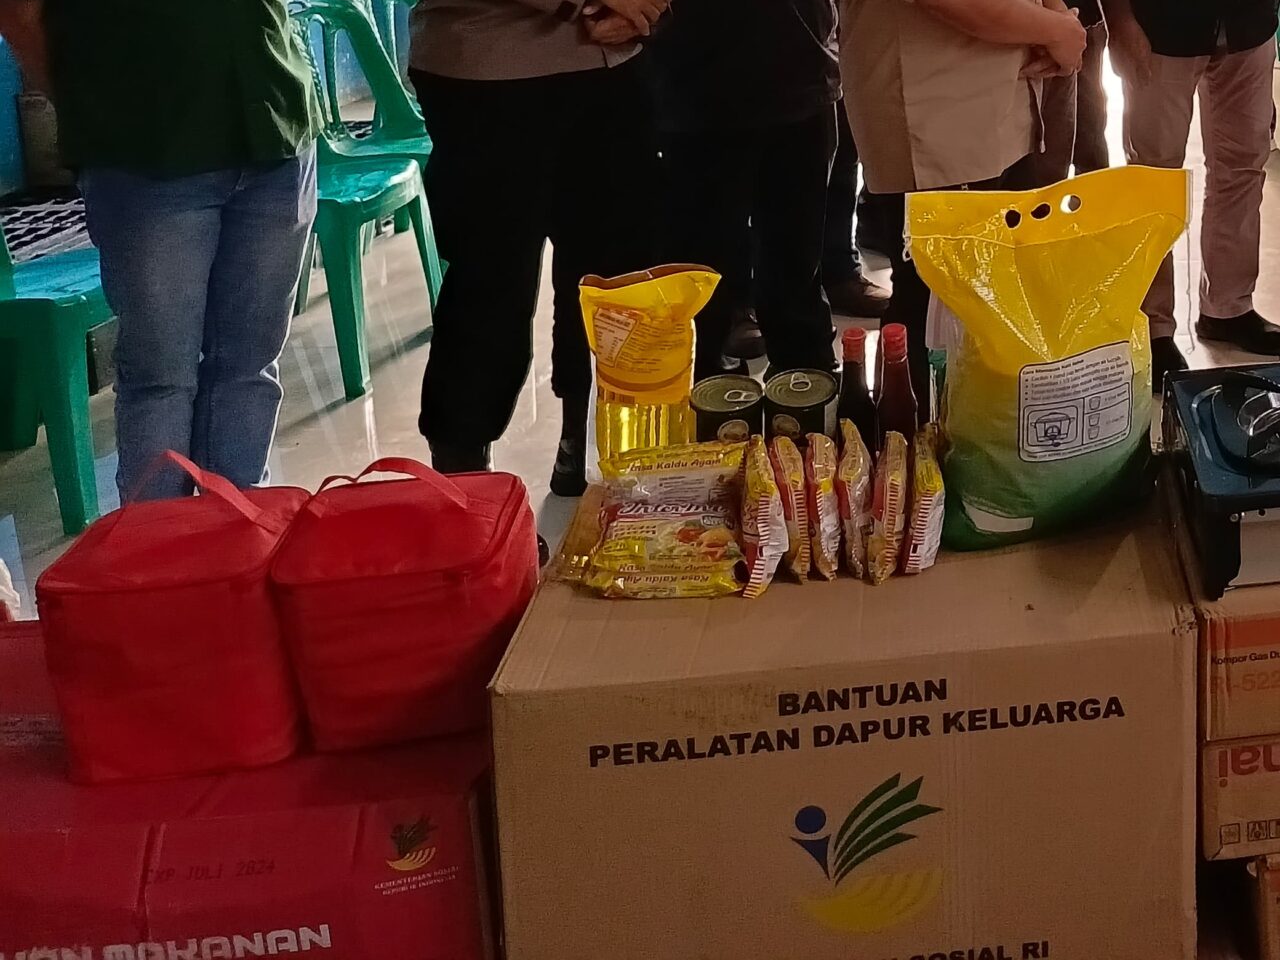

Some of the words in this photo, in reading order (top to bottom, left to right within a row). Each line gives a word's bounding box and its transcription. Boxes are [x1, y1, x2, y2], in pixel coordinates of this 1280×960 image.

[656, 459, 687, 470] Kaldu
[691, 458, 721, 468] Ayam
[1211, 653, 1248, 665] Kompor
[1249, 652, 1268, 662] Gas
[777, 678, 948, 717] BANTUAN
[588, 727, 801, 768] PERALATAN
[812, 714, 931, 748] DAPUR
[942, 696, 1125, 734] KELUARGA
[102, 924, 332, 960] MAKANAN
[1021, 940, 1049, 960] RI
